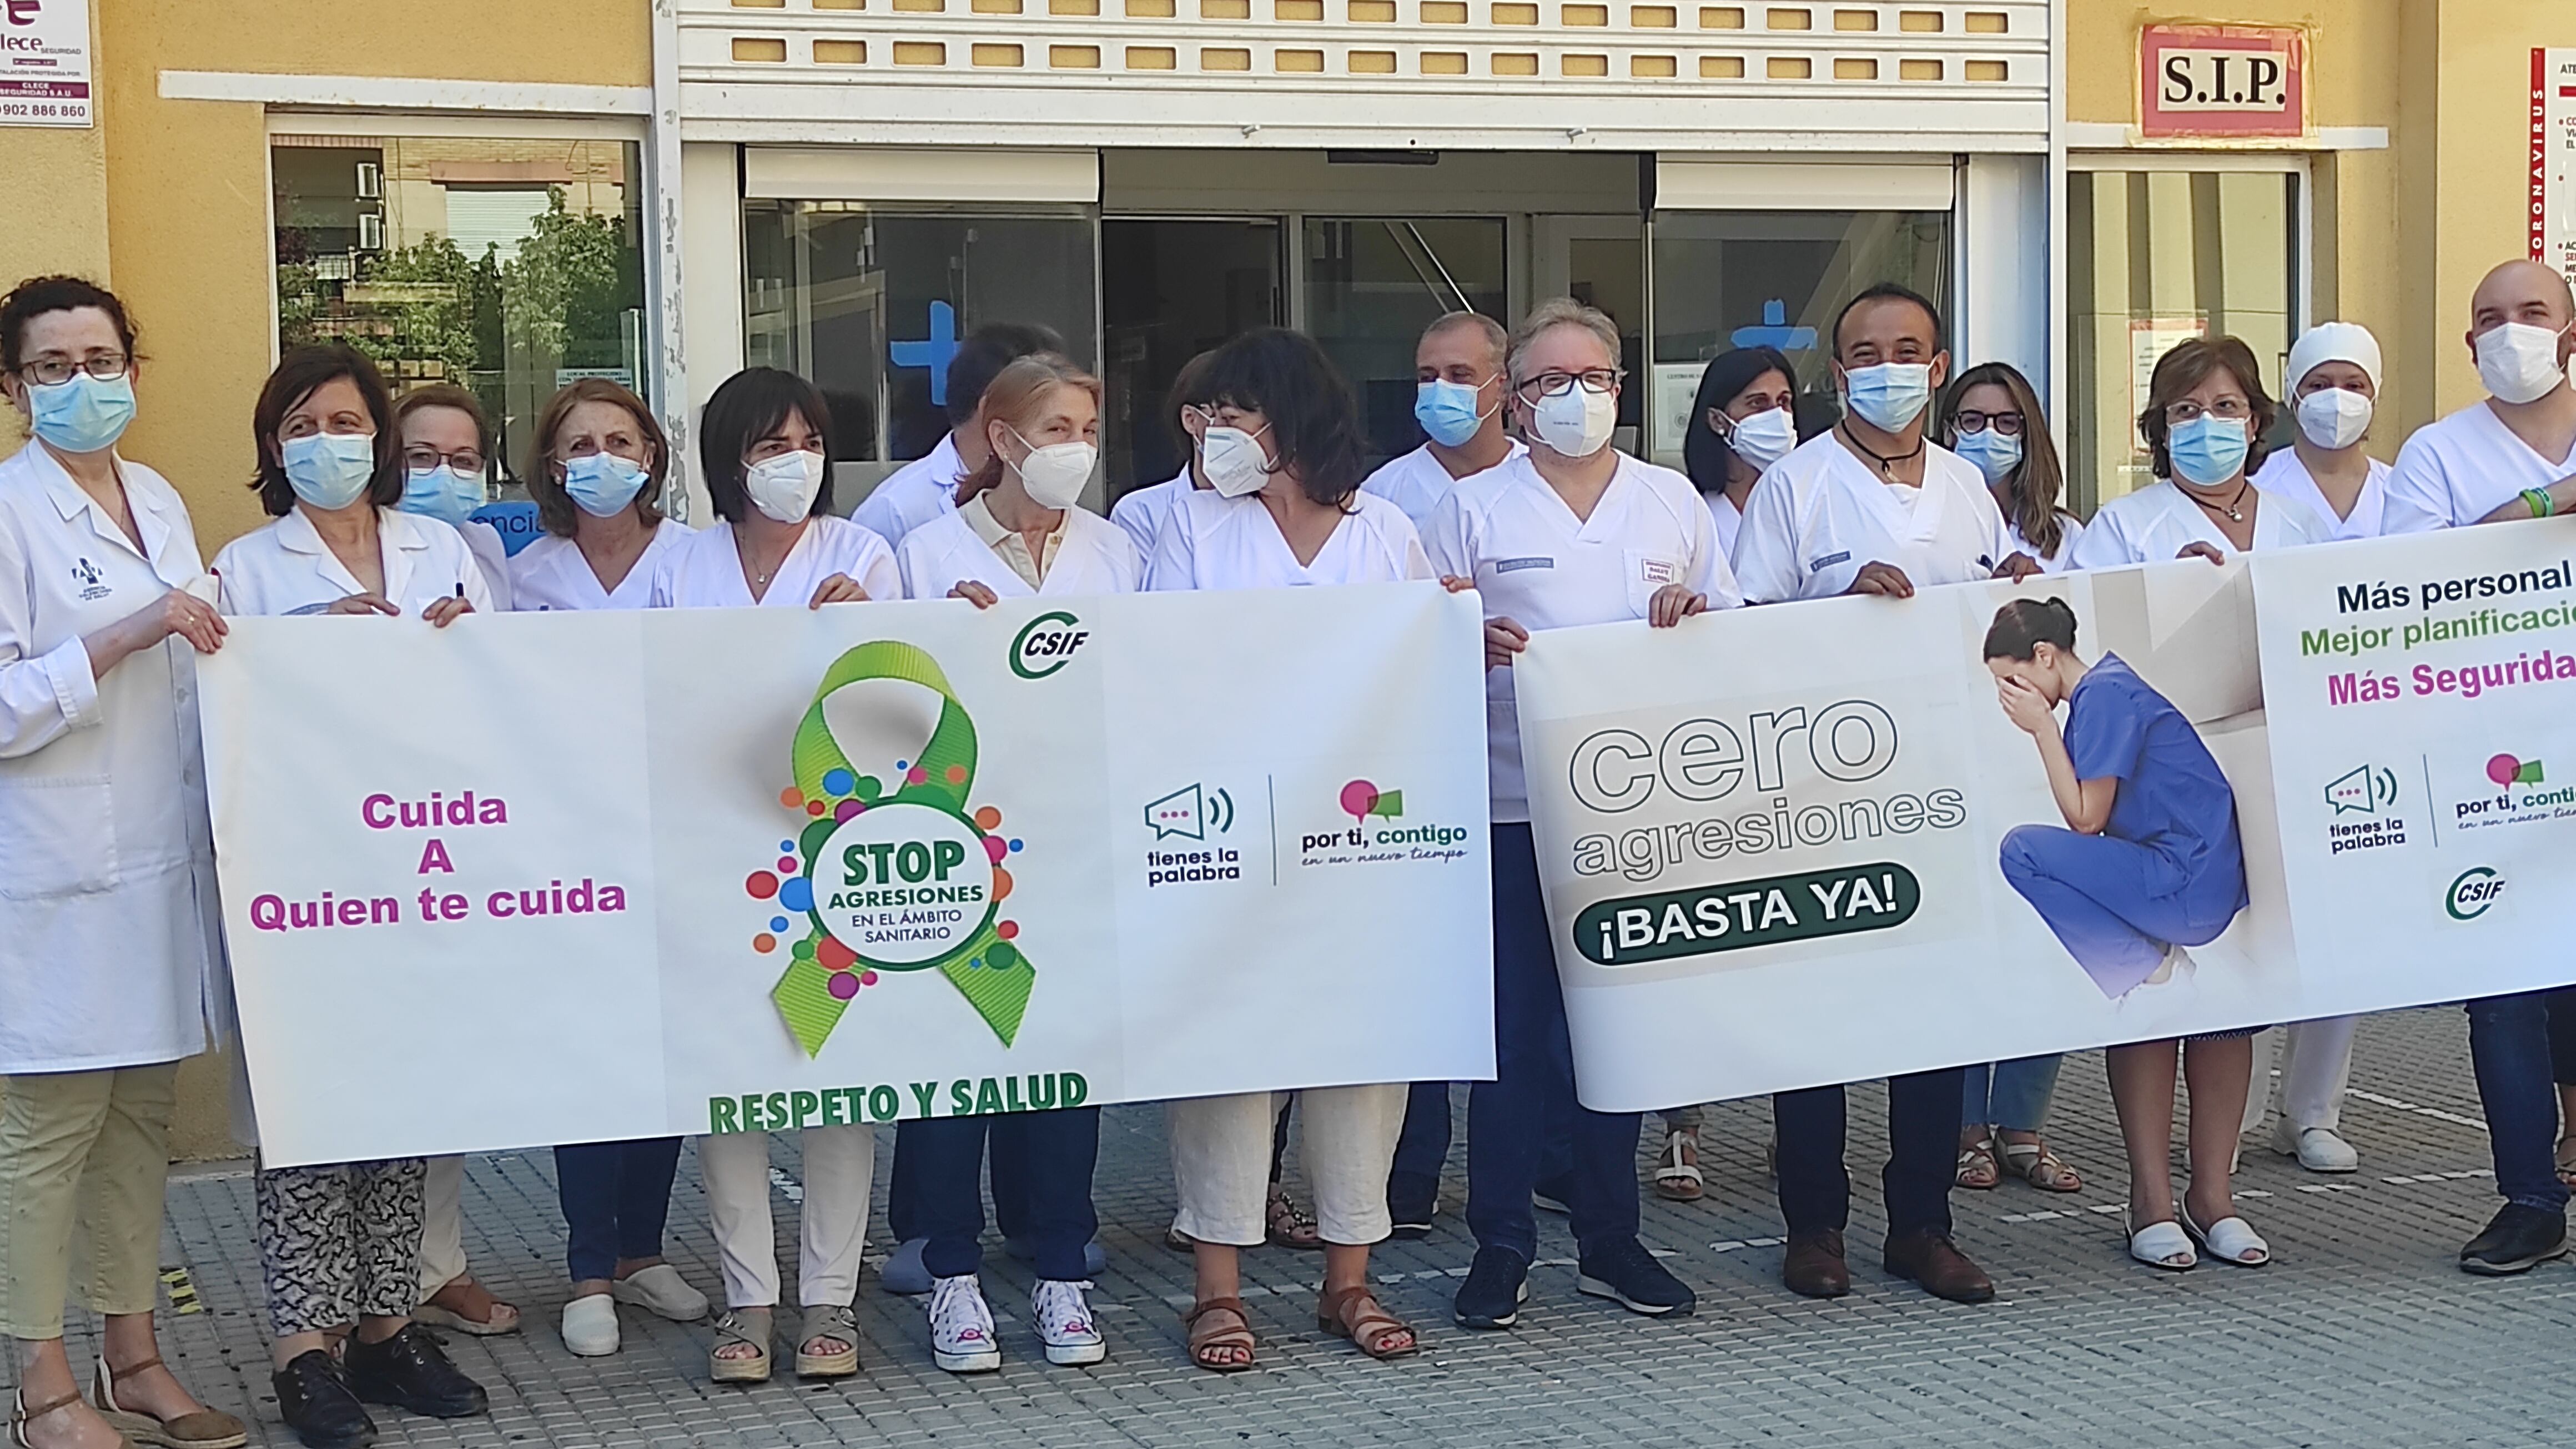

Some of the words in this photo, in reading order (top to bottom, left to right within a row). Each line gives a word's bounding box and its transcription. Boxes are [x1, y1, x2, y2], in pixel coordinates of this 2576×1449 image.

[2165, 56, 2285, 104] S.I.P.
[3, 104, 28, 115] 902
[32, 105, 57, 116] 886
[61, 105, 85, 117] 860
[2337, 581, 2410, 613] Más
[2422, 560, 2572, 610] personal
[2301, 625, 2393, 657] Mejor
[2403, 600, 2576, 650] planificaci
[2328, 670, 2401, 706] Más
[1569, 700, 1898, 813] cero
[362, 791, 507, 829] Cuida
[2456, 799, 2492, 818] por
[2496, 794, 2517, 812] ti,
[2523, 786, 2576, 807] conti
[2508, 813, 2549, 823] nuevo
[1302, 833, 1341, 853] por
[1347, 828, 1368, 848] ti,
[1376, 824, 1467, 846] contigo
[1573, 788, 1966, 882] agresiones
[2330, 819, 2381, 837] tienes
[2386, 817, 2403, 831] la
[2331, 832, 2406, 855] palabra
[417, 839, 455, 874] A
[842, 840, 965, 886] STOP
[1148, 851, 1212, 867] tienes
[1219, 847, 1239, 862] la
[1302, 857, 1323, 866] en
[1357, 851, 1406, 863] nuevo
[1410, 847, 1468, 863] tiempo
[1149, 865, 1240, 887] palabra
[250, 892, 399, 932] Quien
[418, 887, 469, 921] te
[487, 878, 626, 917] cuida
[828, 885, 984, 909] AGRESIONES
[852, 914, 873, 927] EN
[879, 913, 895, 925] EL
[899, 909, 962, 925] ÁMBITO
[1600, 888, 1798, 959] ¡BASTA
[1809, 873, 1898, 921] YA!
[865, 927, 951, 943] SANITARIO
[710, 1084, 899, 1134] RESPETO
[909, 1082, 938, 1118] Y
[951, 1073, 1088, 1116] SALUD
